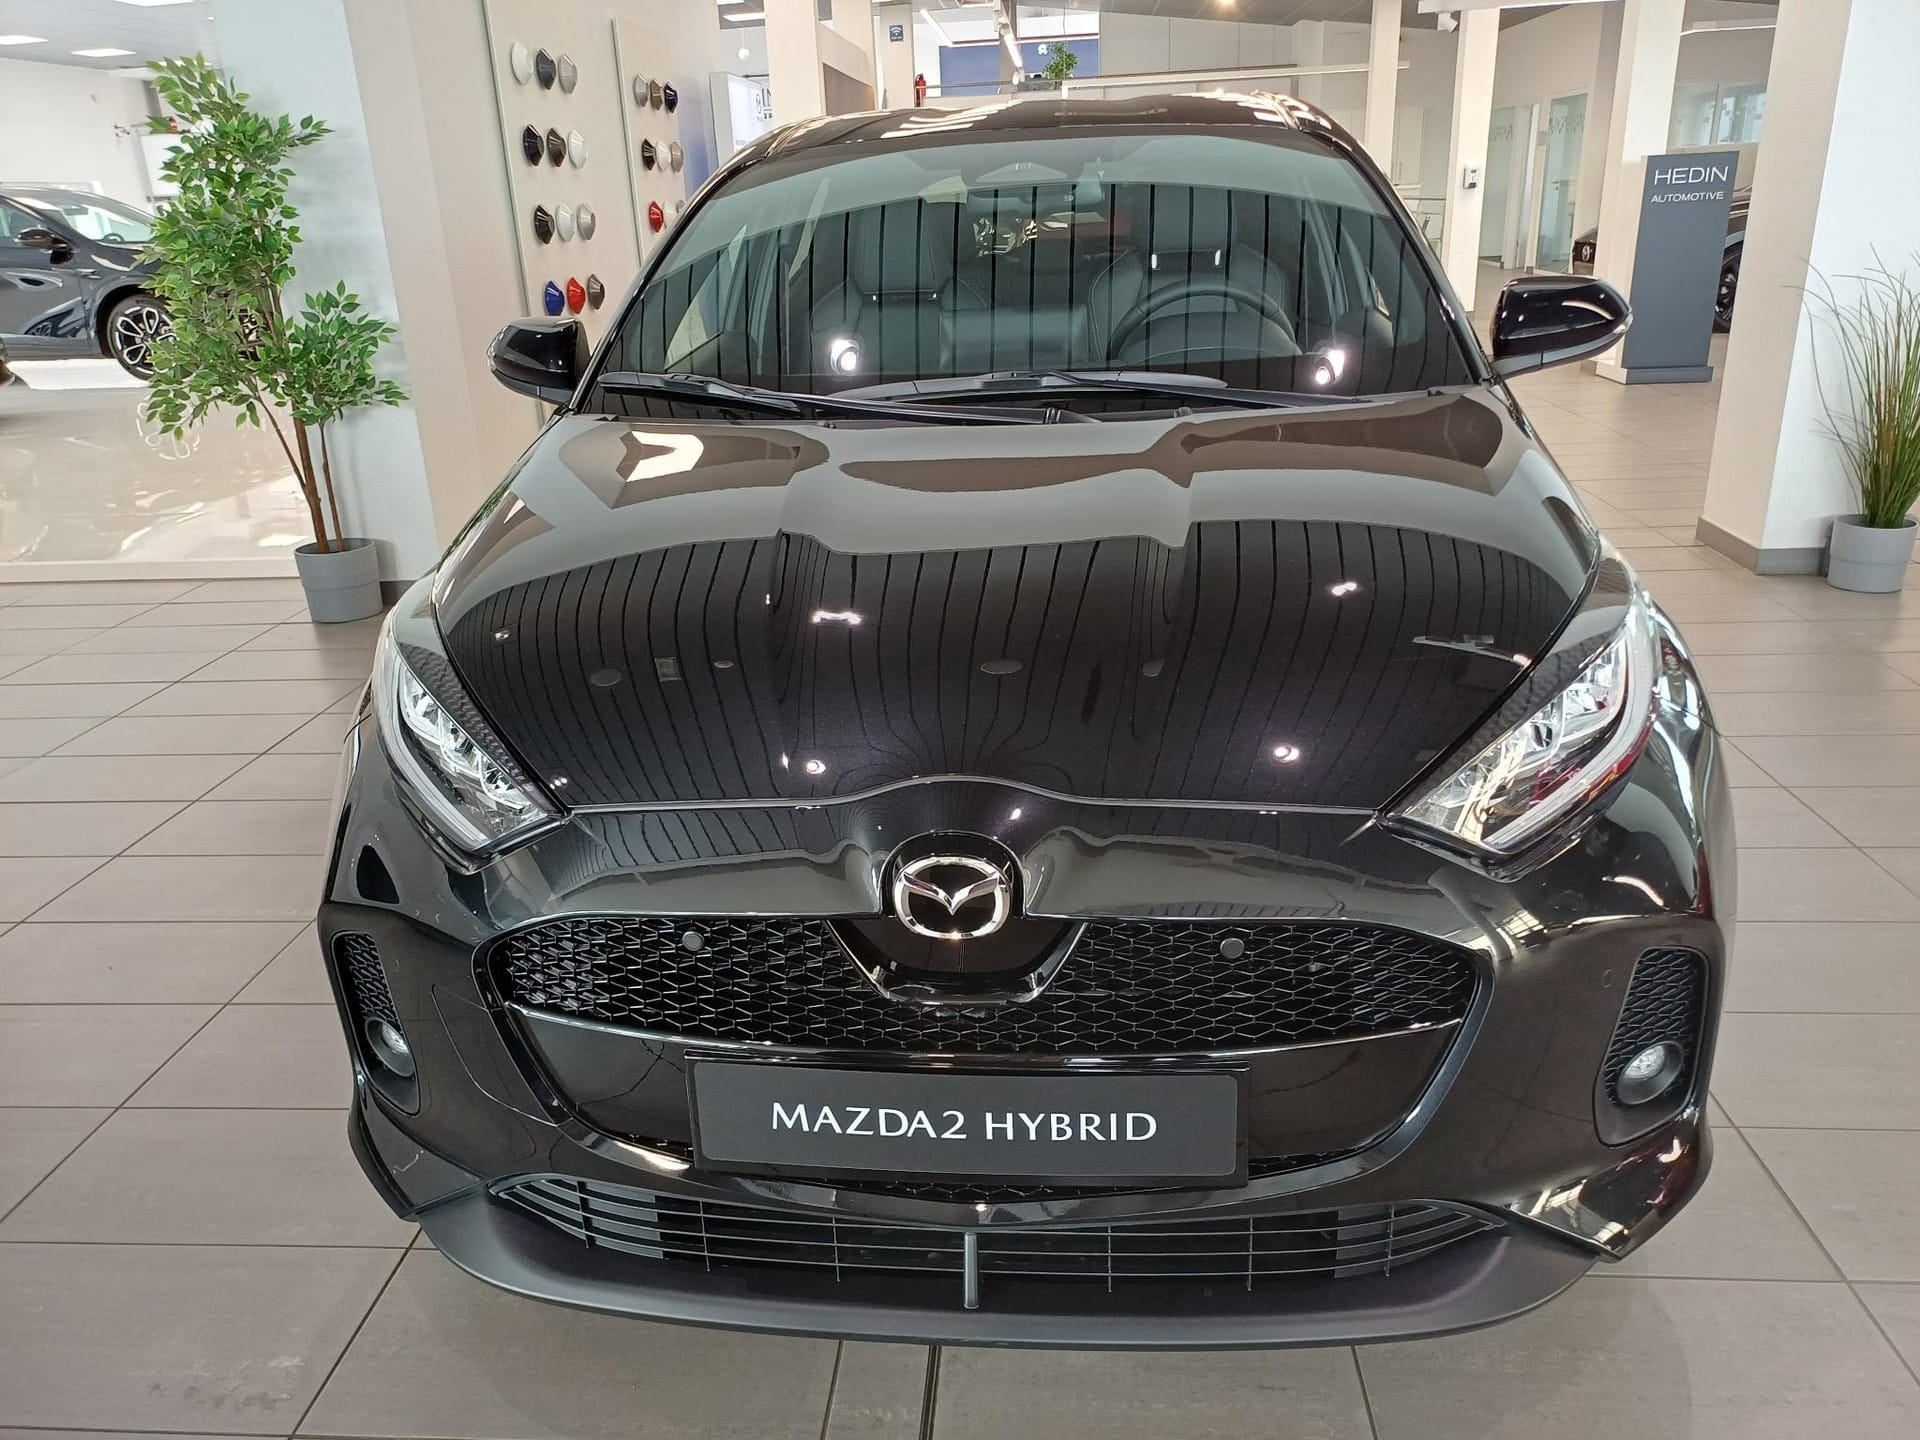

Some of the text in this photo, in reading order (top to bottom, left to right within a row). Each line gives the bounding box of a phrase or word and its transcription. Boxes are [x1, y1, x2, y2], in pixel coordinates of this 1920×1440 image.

[1653, 165, 1729, 186] HEDIN
[1650, 190, 1725, 204] AUTOMOTIVE
[772, 1102, 1158, 1141] MAZDA2 HYBRID
